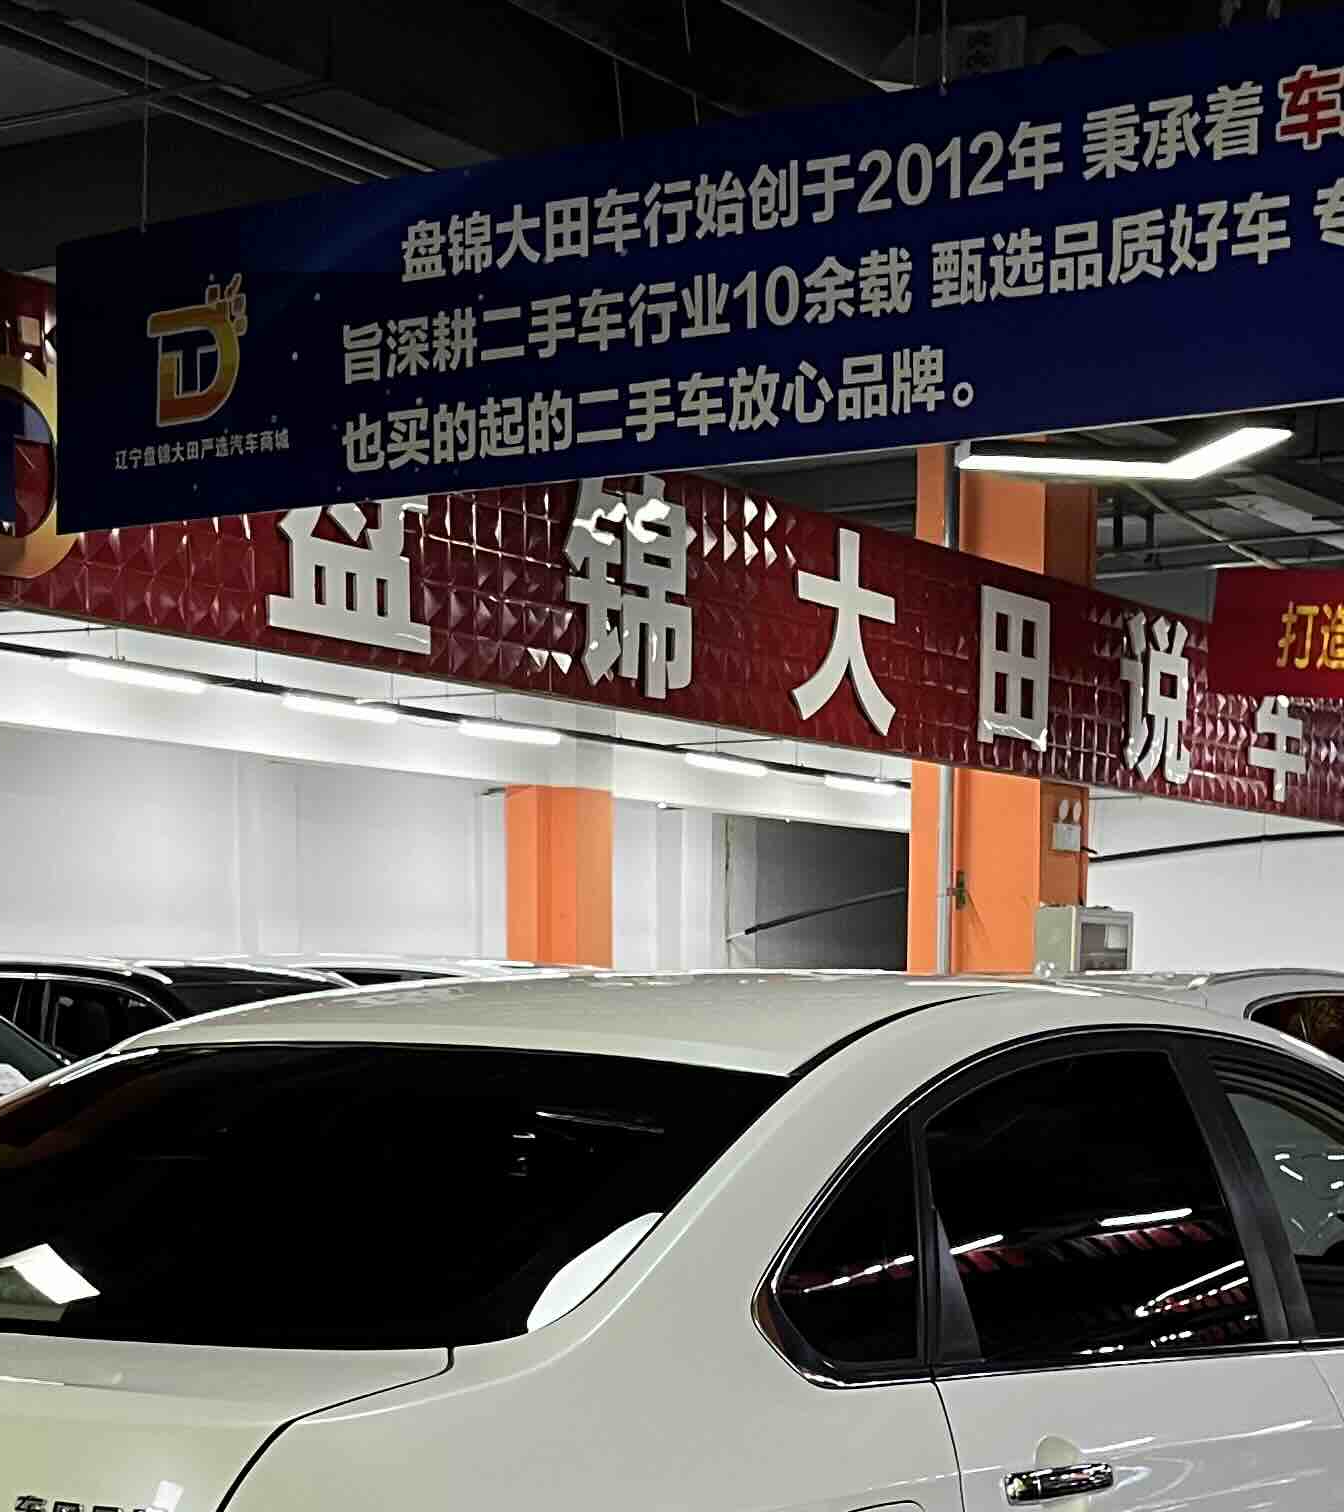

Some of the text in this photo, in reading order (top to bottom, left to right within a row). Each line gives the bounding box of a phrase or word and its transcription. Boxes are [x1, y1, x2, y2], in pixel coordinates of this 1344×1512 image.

[400, 119, 1065, 284] 盘锦大田车行始创于2012年
[1082, 81, 1264, 183] 秉承着
[341, 246, 914, 386] 旨深耕二手车行业10余载
[931, 190, 1292, 309] 甄选品质好车
